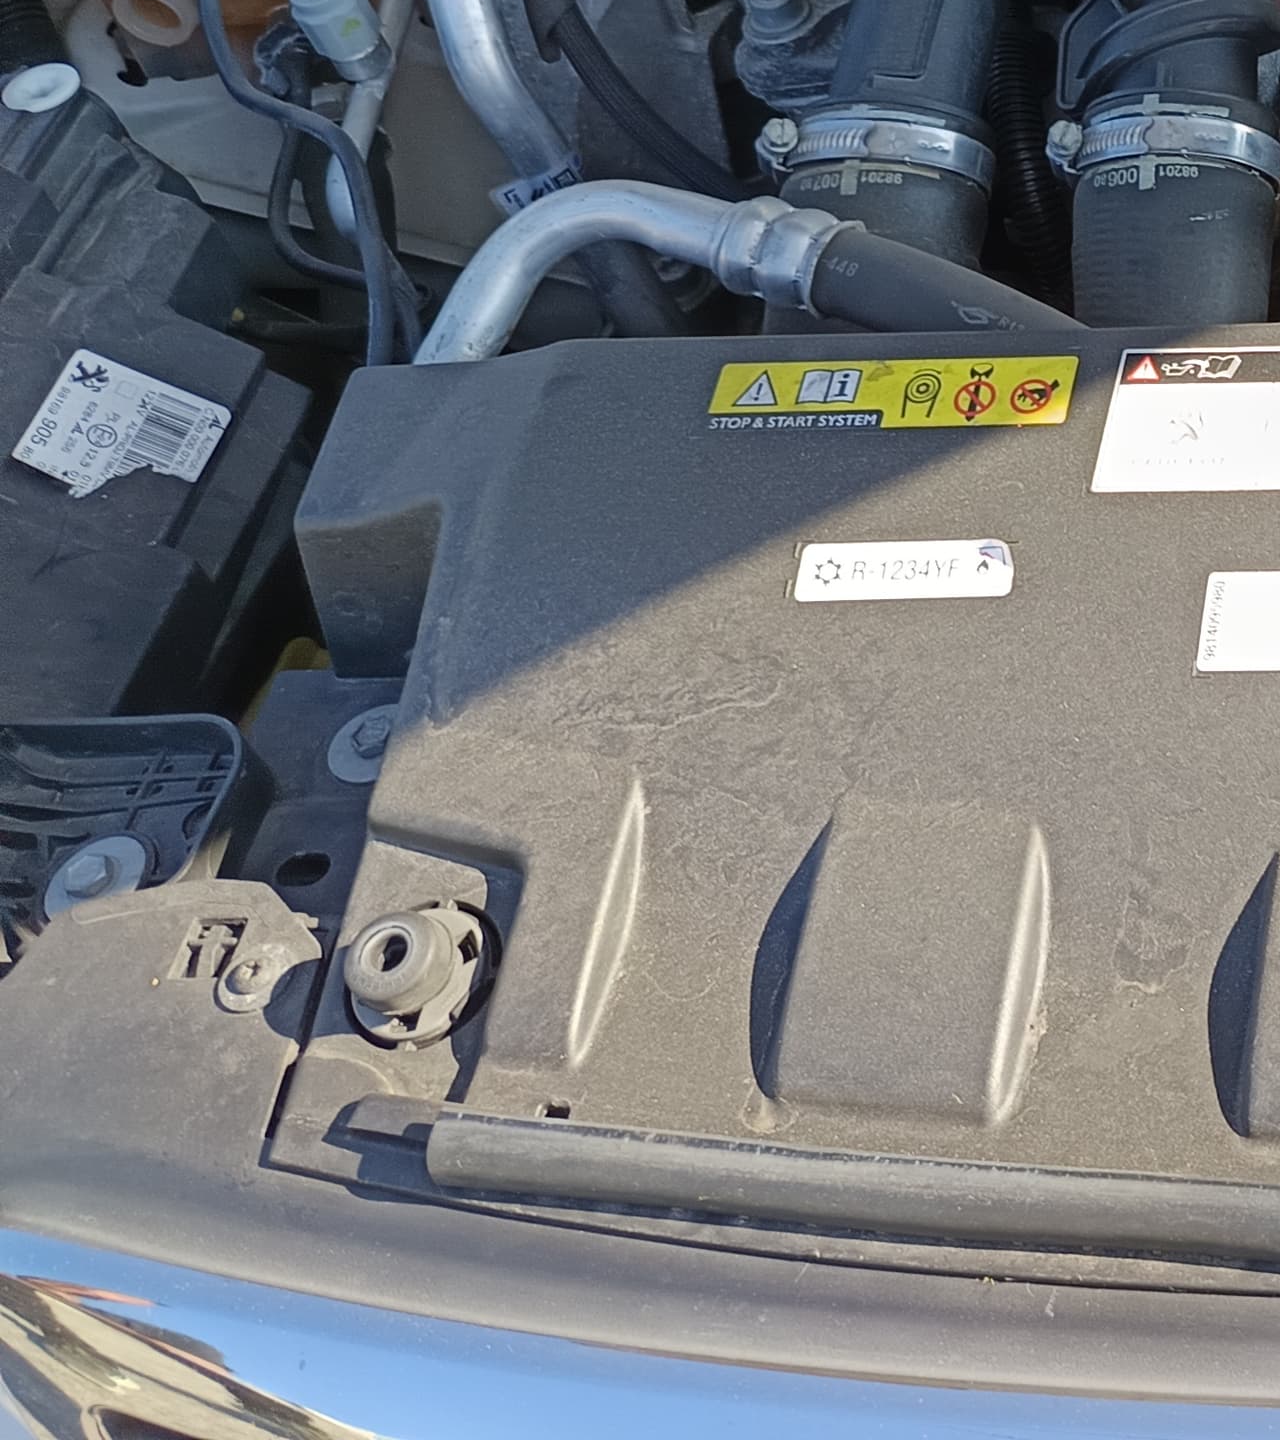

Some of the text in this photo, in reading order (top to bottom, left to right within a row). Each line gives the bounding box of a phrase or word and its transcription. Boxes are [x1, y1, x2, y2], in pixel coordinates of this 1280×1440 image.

[708, 413, 878, 430] STOP & START SYSTEM
[850, 558, 960, 581] R-1234YF
